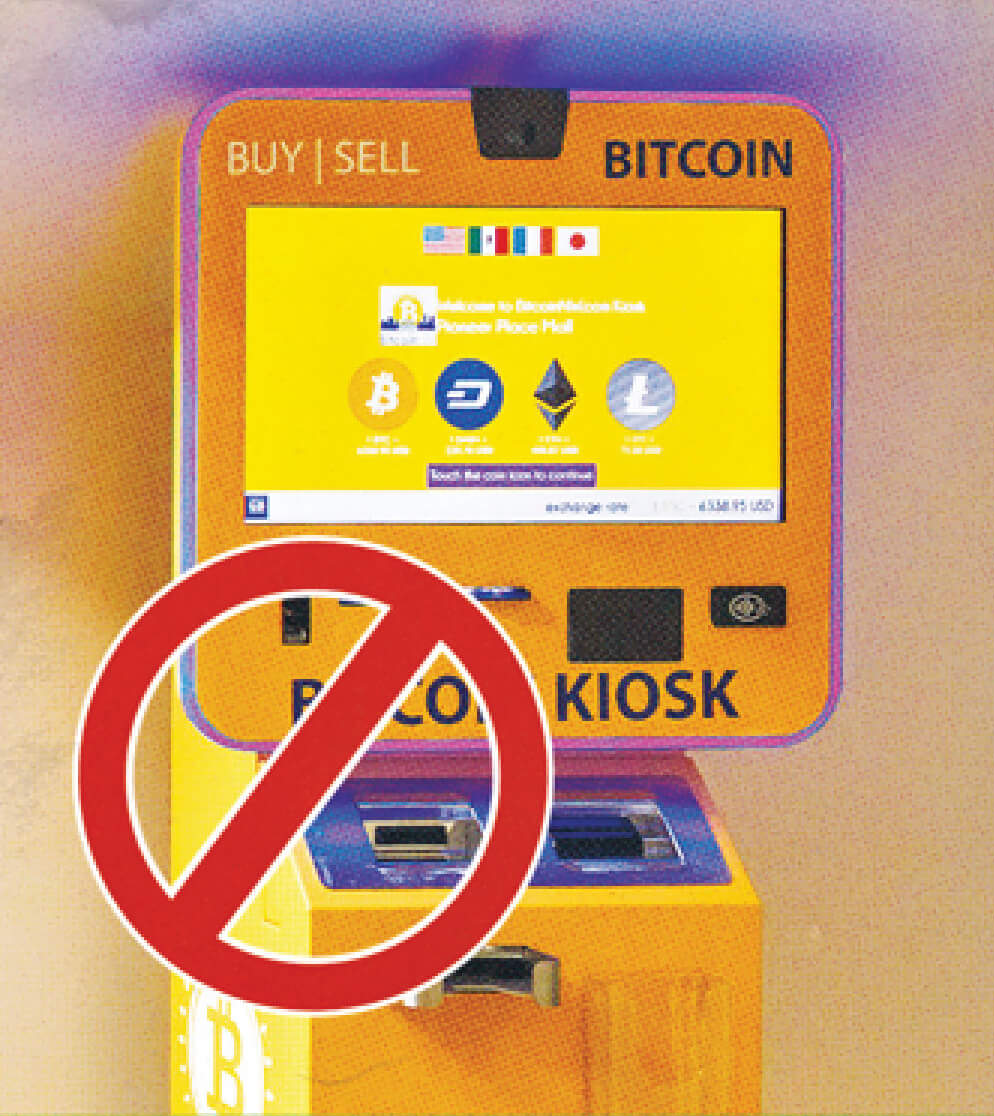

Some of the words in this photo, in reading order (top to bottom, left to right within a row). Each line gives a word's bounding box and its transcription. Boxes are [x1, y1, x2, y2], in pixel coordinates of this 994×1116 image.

[227, 141, 303, 175] BUY
[335, 141, 420, 175] SELL
[604, 140, 794, 179] BITCOIN
[556, 670, 740, 722] KIOSK
